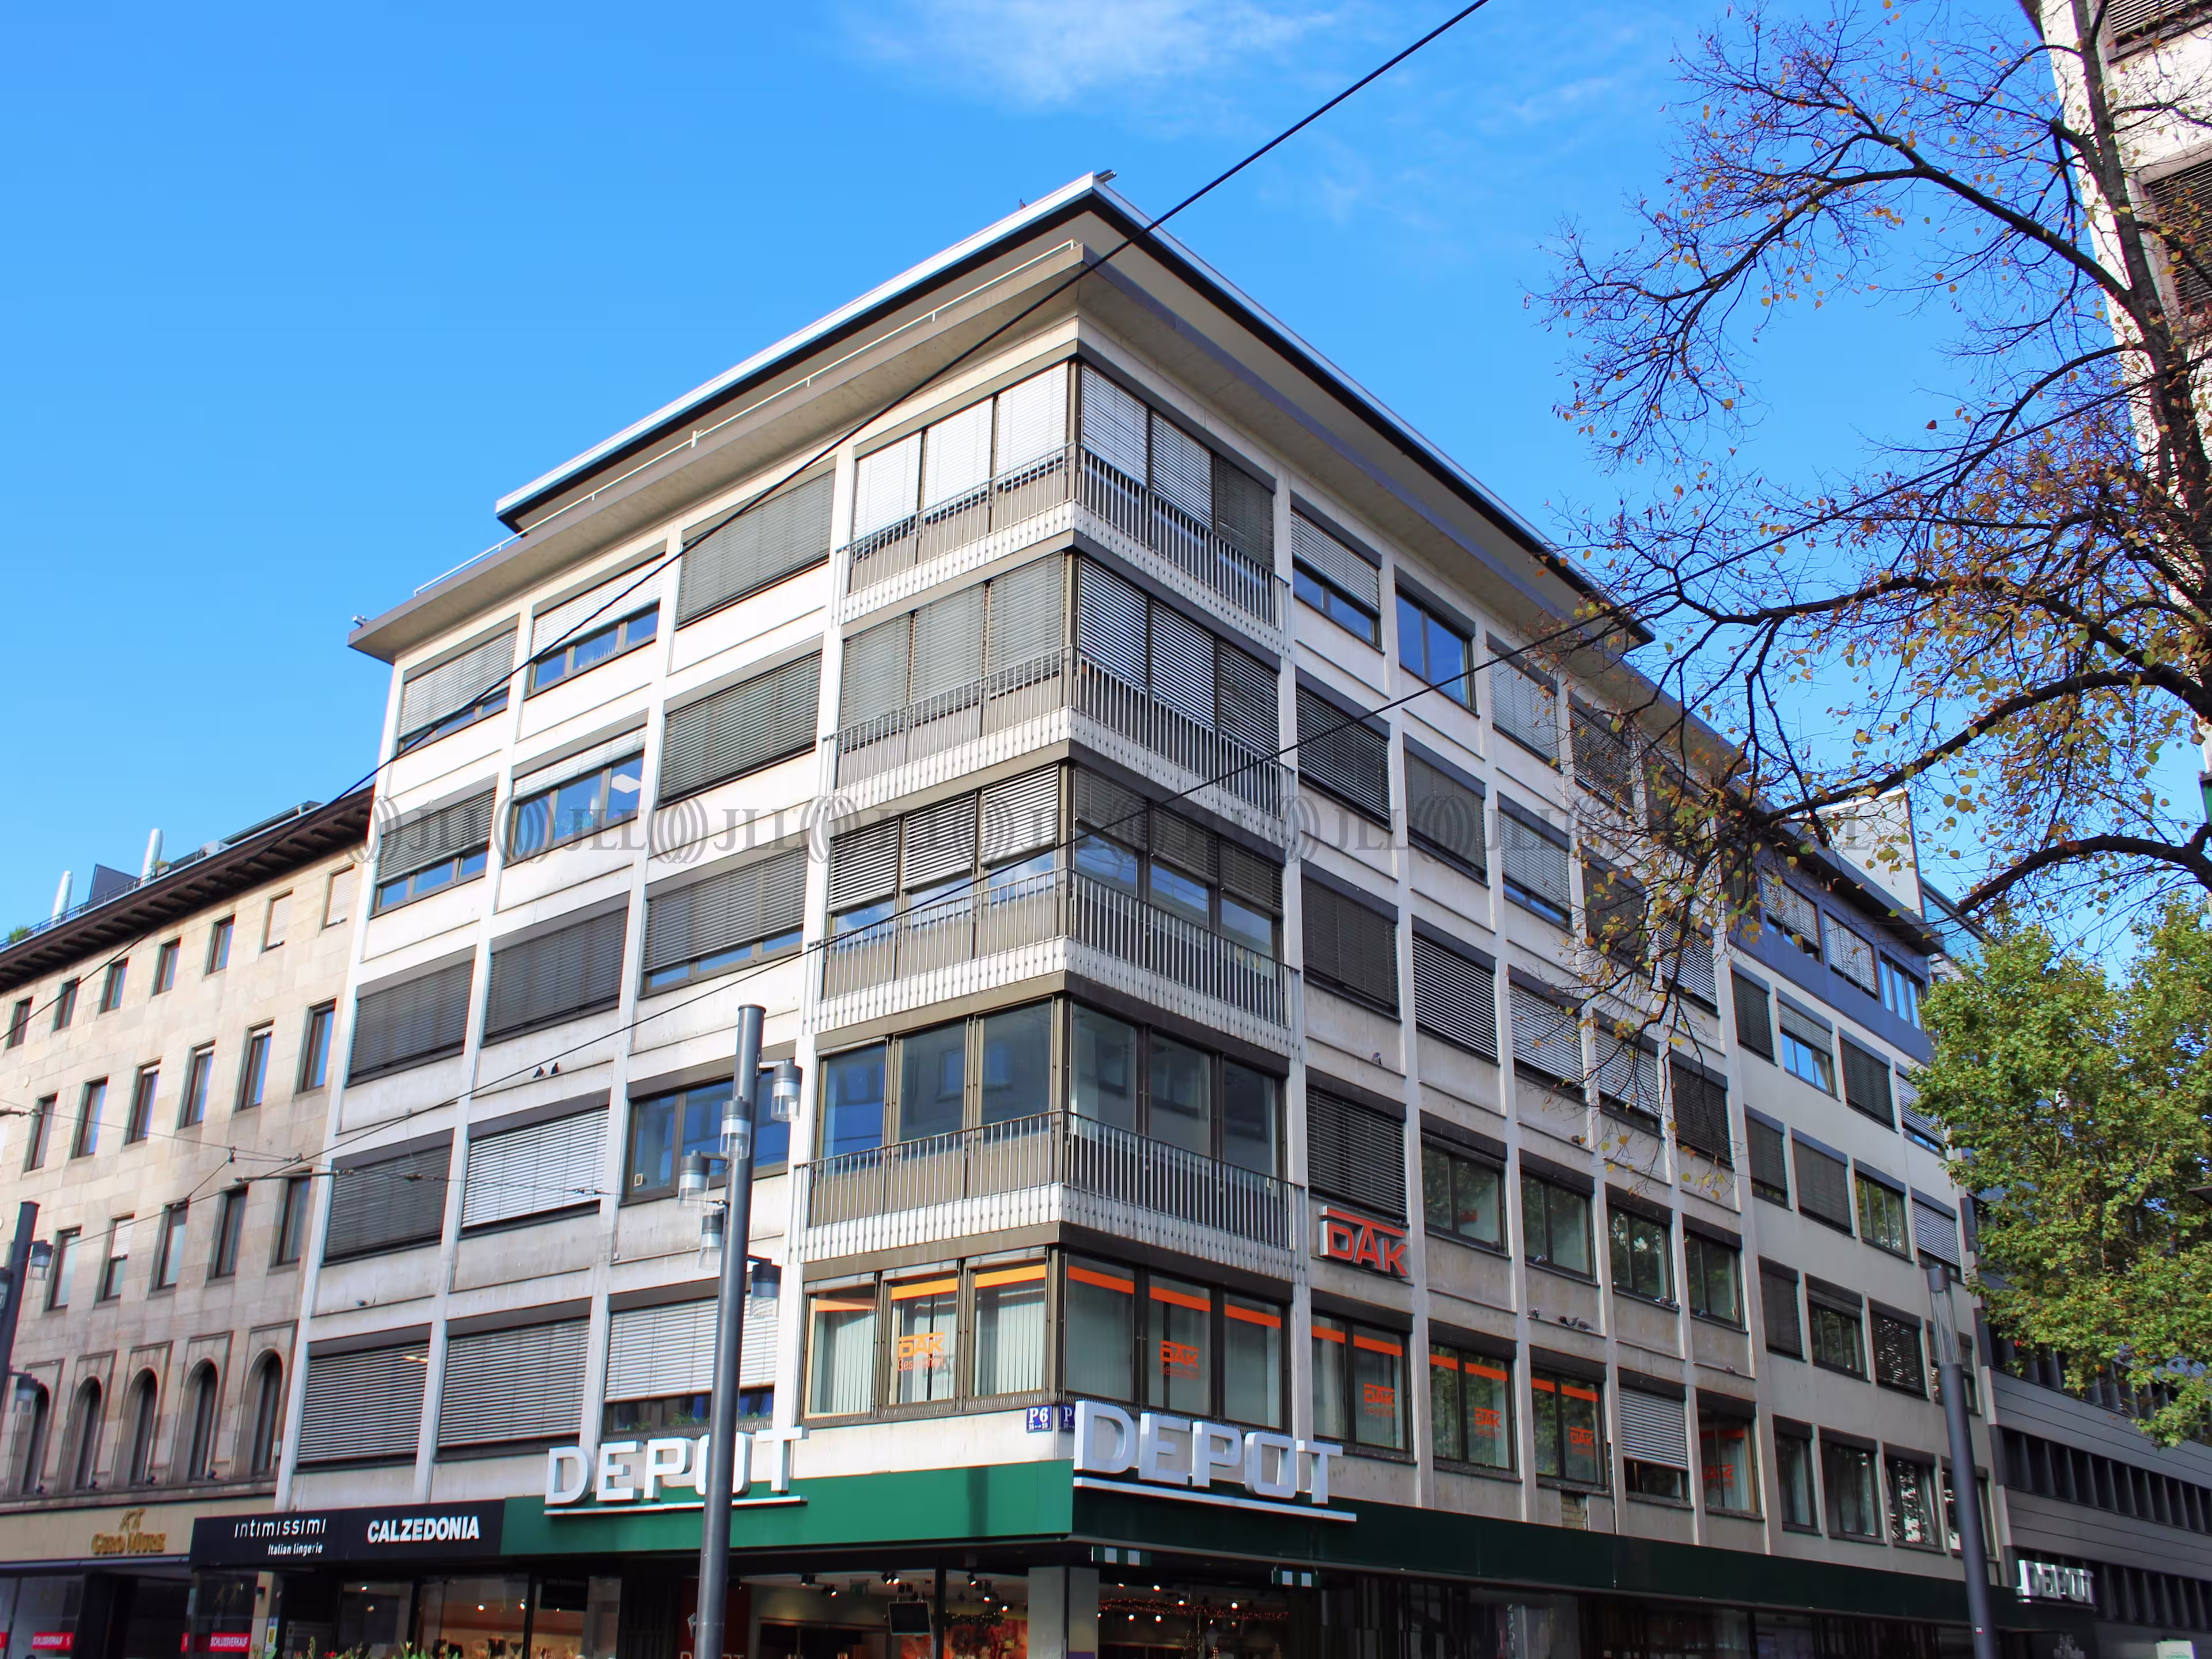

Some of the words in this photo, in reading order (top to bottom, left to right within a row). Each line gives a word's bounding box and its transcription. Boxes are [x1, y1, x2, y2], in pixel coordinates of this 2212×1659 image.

[1319, 1206, 1408, 1277] DAK
[898, 1332, 945, 1358] DAK
[1160, 1340, 1199, 1369] DAK
[1363, 1382, 1395, 1407] DAK
[1029, 1407, 1048, 1423] P6
[1063, 1406, 1075, 1422] P
[1474, 1406, 1501, 1429] DAK
[1569, 1426, 1594, 1448] DAK
[1074, 1400, 1343, 1504] DEPOT
[544, 1426, 808, 1506] DEPOT
[367, 1516, 480, 1544] CALZEDONIA
[267, 1544, 291, 1555] Italian
[293, 1542, 323, 1556] lingerie
[210, 1636, 248, 1647] SCHLUSSVERKAUF
